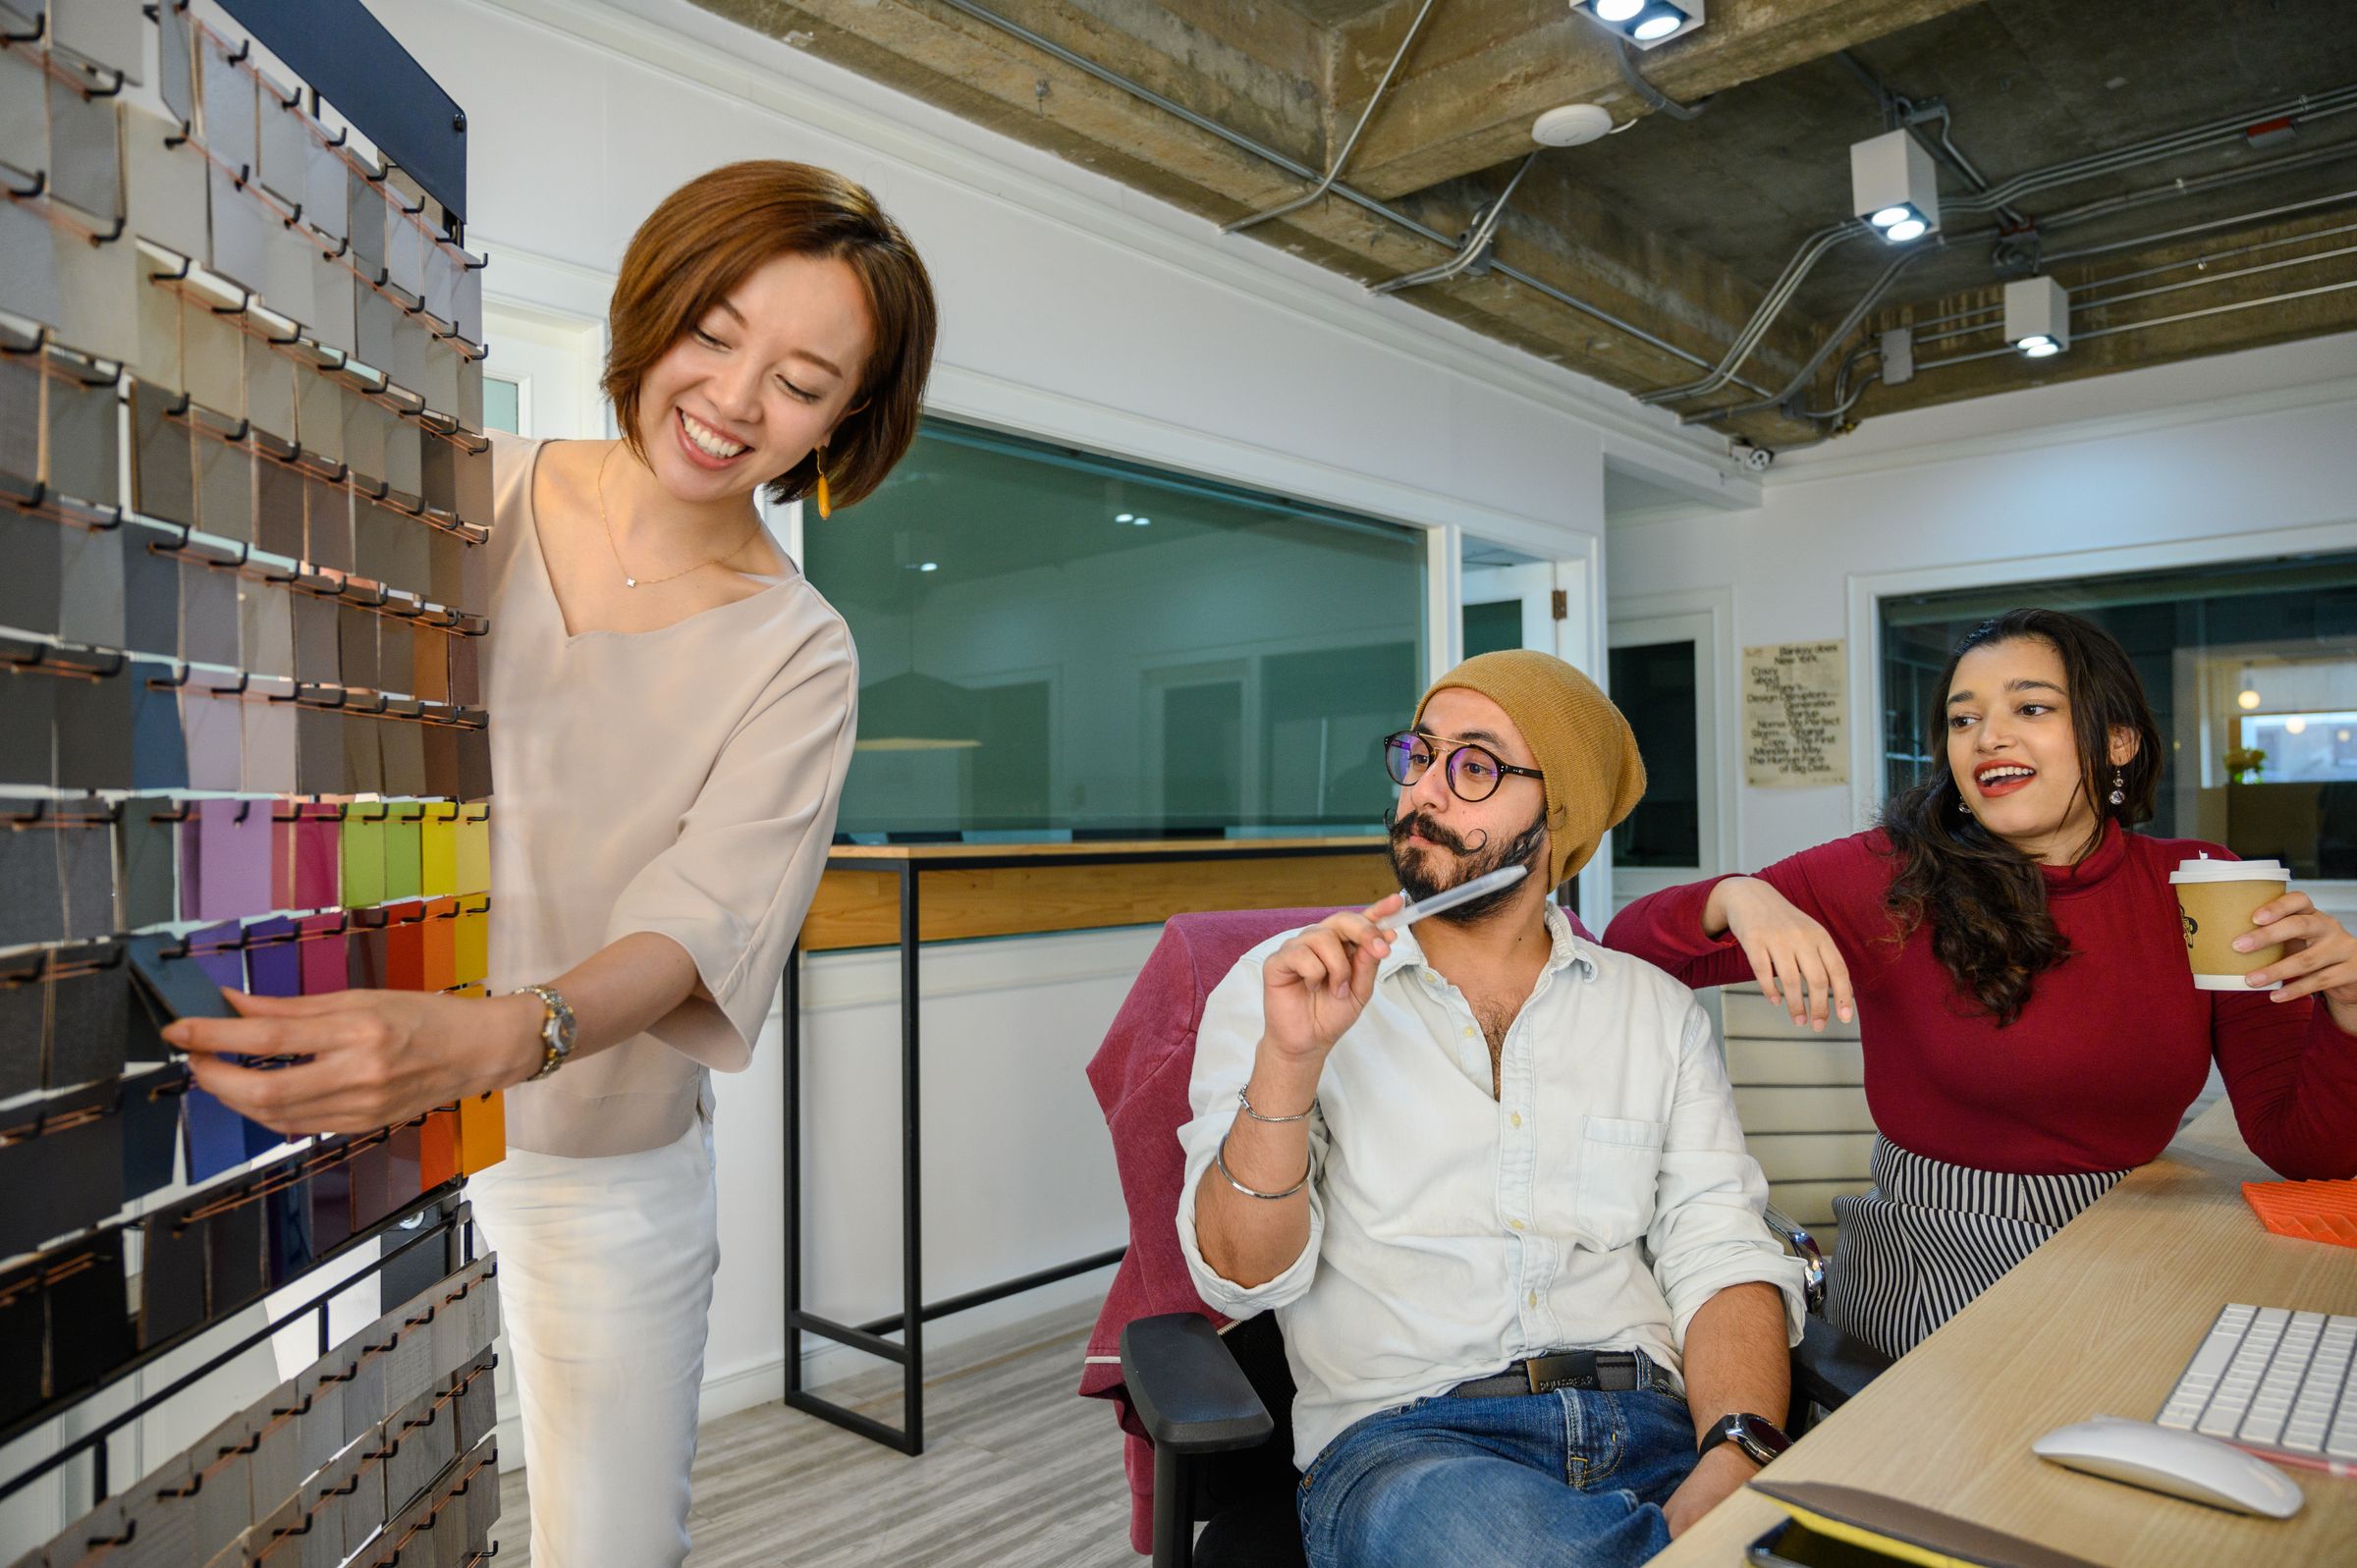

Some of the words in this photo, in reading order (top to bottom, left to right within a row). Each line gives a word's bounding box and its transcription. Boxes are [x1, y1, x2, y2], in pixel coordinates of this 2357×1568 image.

[1779, 646, 1812, 657] Banksy
[1774, 655, 1795, 665] New
[1751, 666, 1779, 676] Crazy
[1746, 693, 1778, 704] Design
[1783, 699, 1836, 710] Generation
[1804, 717, 1840, 728] Perfect
[1813, 734, 1836, 745] First
[1753, 746, 1790, 757] Monday
[1748, 756, 1765, 765] The
[1779, 765, 1789, 774] of
[1790, 764, 1807, 776] Big
